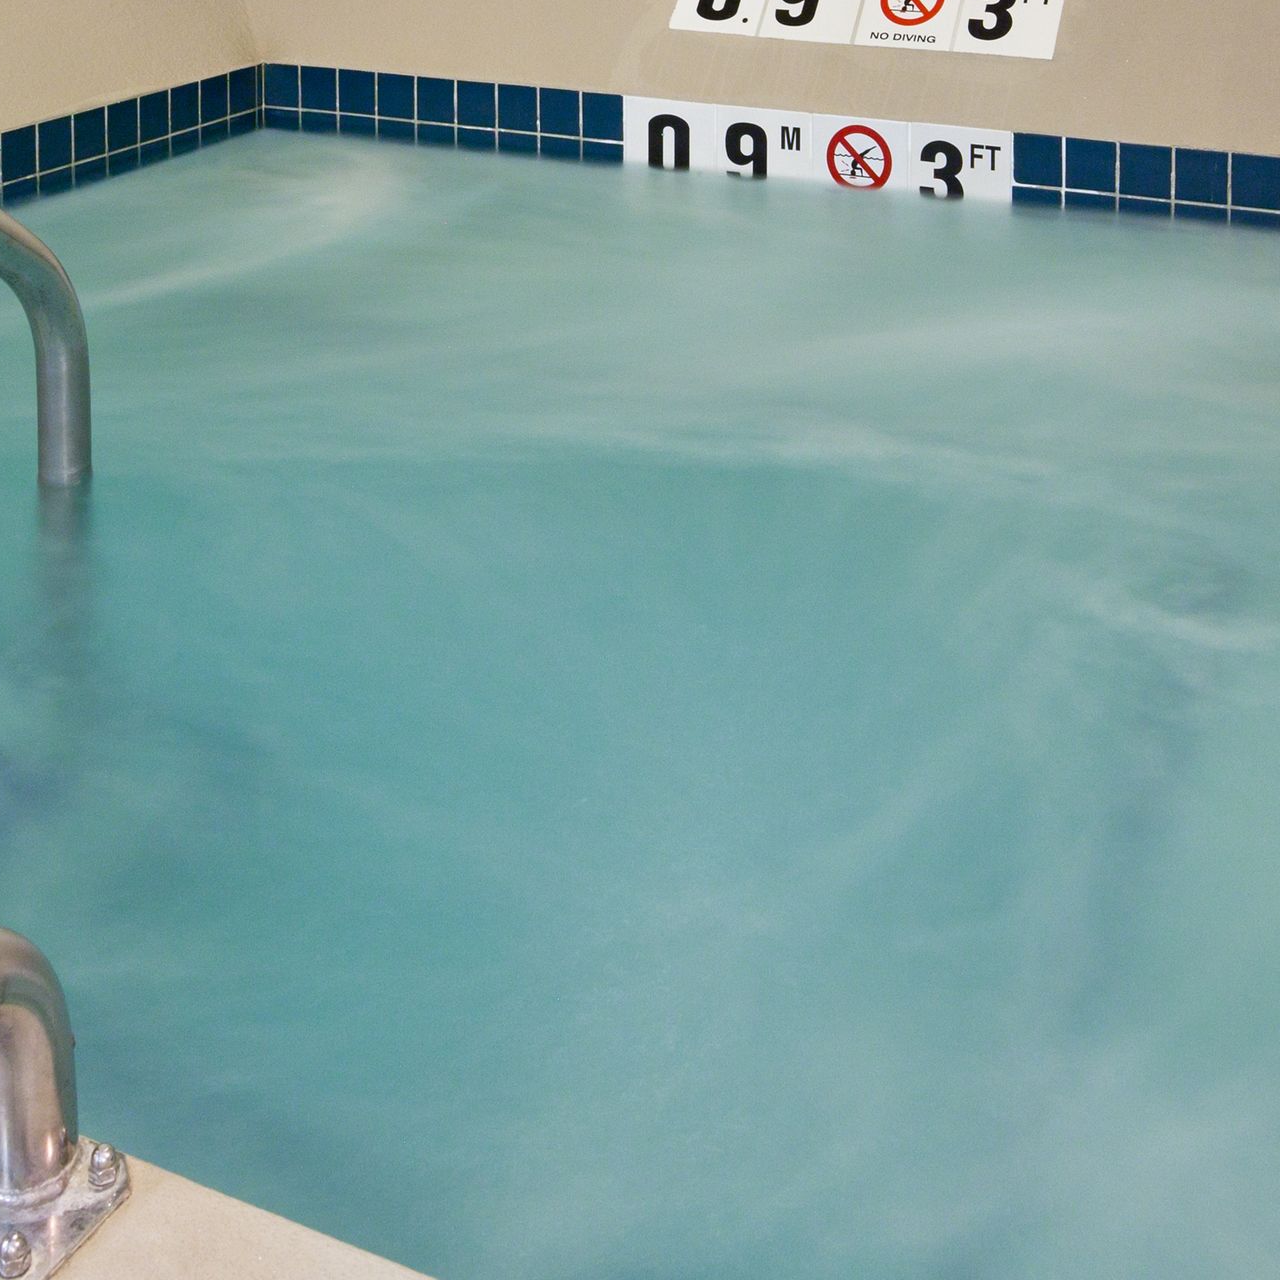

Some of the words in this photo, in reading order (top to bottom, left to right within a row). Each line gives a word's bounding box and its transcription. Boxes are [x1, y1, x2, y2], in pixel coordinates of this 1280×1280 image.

[869, 31, 890, 41] NO
[892, 32, 937, 45] DIVING
[781, 126, 802, 151] M
[920, 140, 965, 201] 3
[970, 144, 1002, 171] FT
